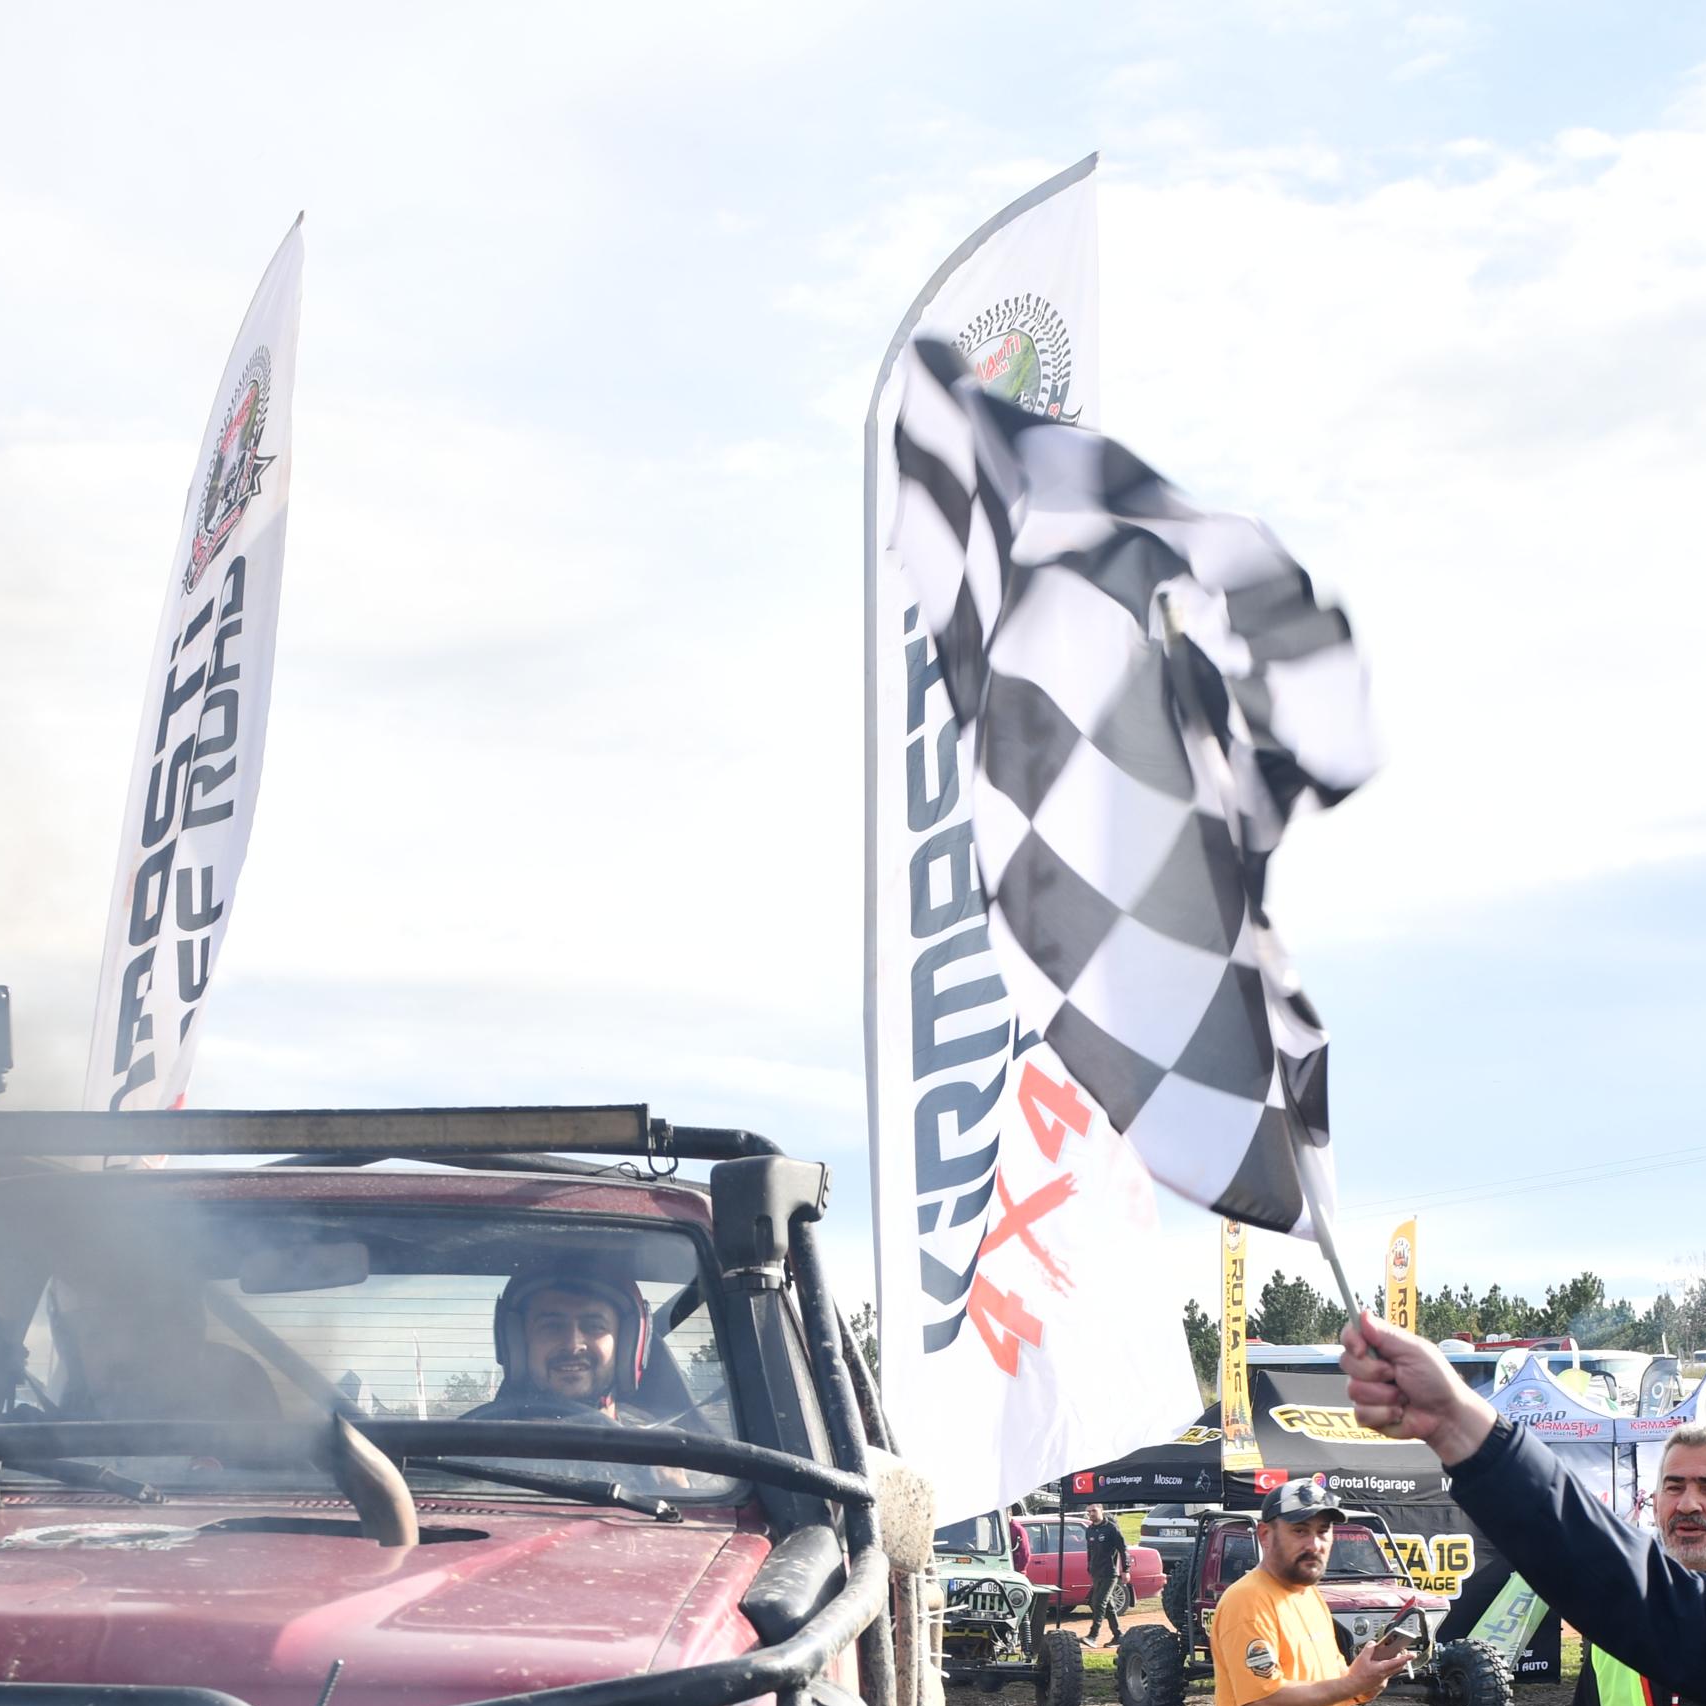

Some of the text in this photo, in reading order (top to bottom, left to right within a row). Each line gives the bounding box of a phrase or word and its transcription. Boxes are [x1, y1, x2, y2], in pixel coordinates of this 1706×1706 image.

[182, 555, 246, 831] ROAD
[1397, 1287, 1408, 1329] RO
[1277, 1409, 1355, 1428] ROT
[1349, 1430, 1389, 1440] GAR
[1153, 1473, 1183, 1486] Moscow
[1328, 1475, 1416, 1493] @rota16garage
[1436, 1542, 1469, 1572] 16
[1521, 1661, 1549, 1672] AUTO
